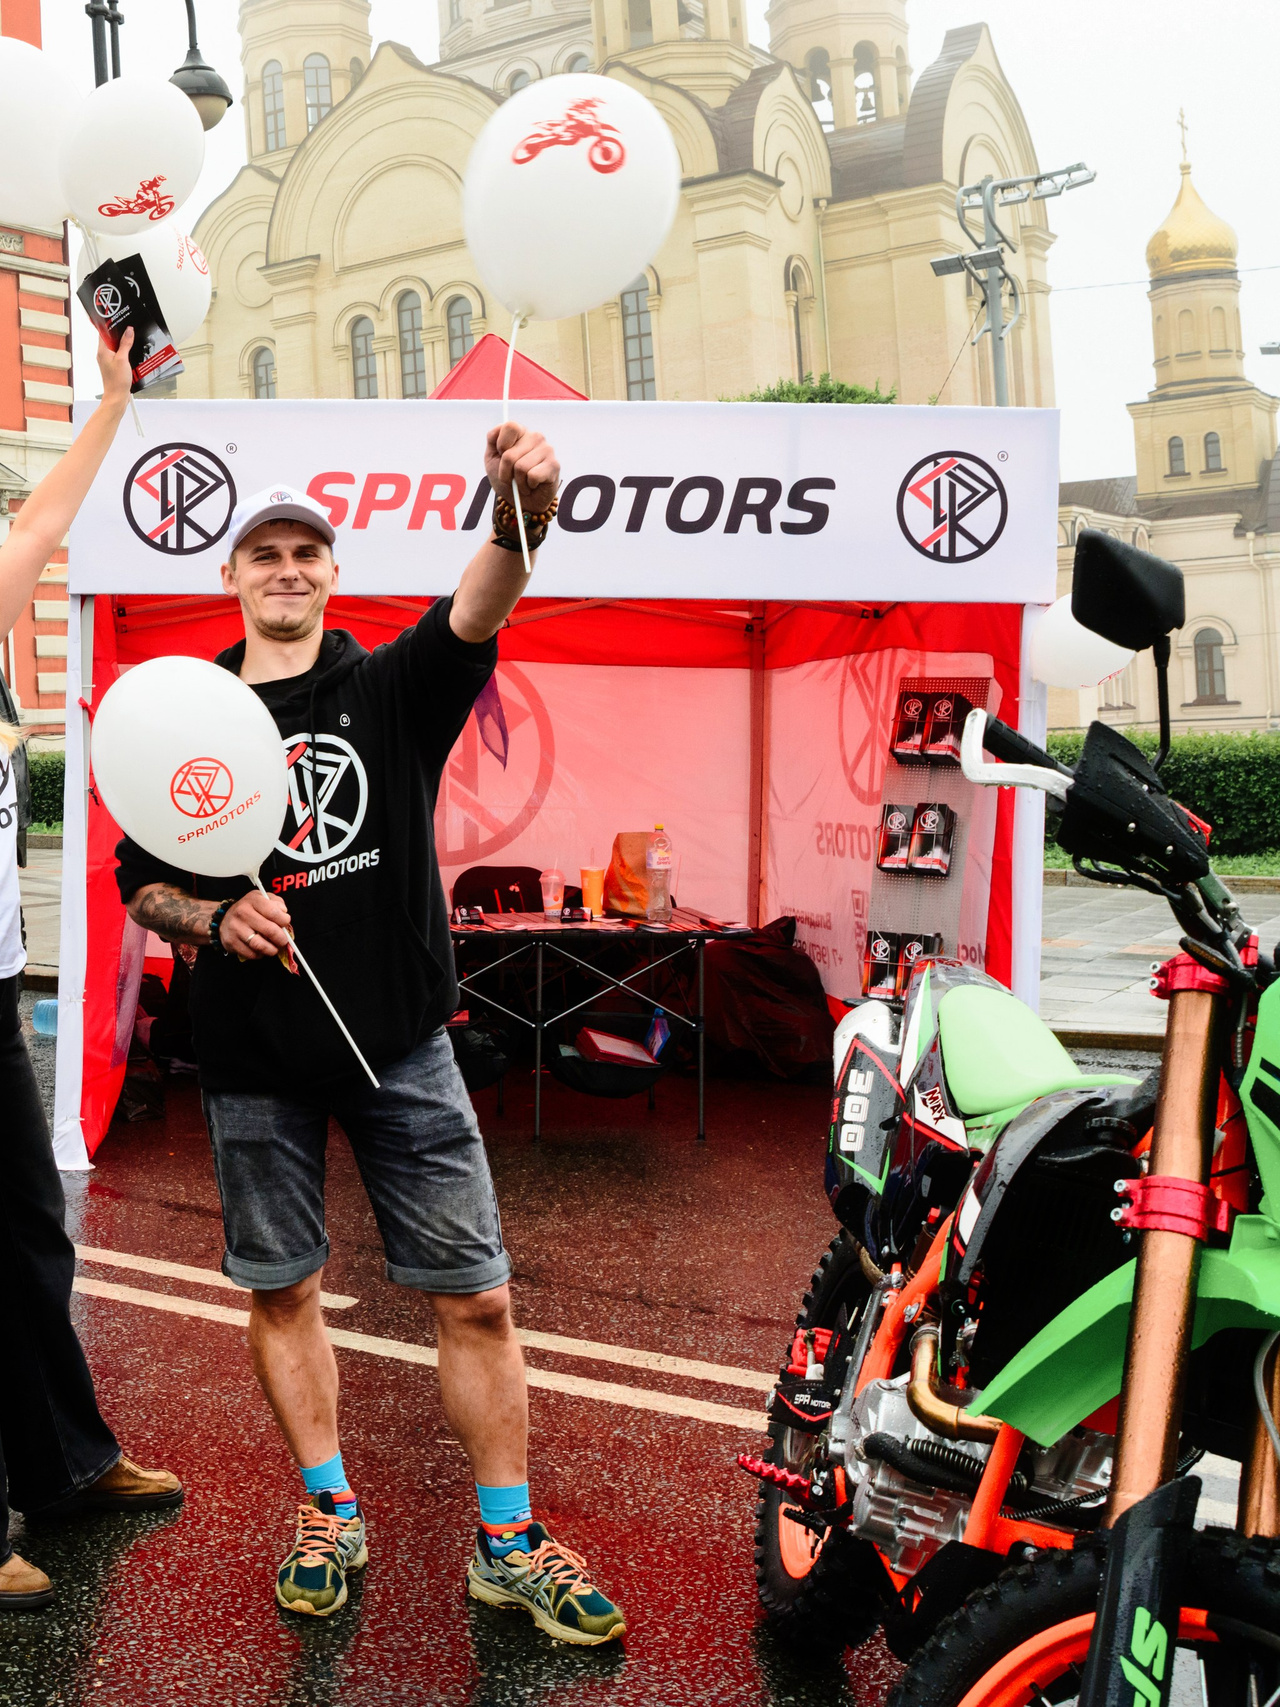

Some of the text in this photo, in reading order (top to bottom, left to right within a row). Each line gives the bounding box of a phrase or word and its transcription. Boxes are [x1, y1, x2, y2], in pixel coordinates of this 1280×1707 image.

[177, 790, 262, 845] SPRMOTORS
[272, 848, 380, 894] SPRMOTORS
[839, 1068, 875, 1152] 300
[920, 1082, 948, 1125] MAX
